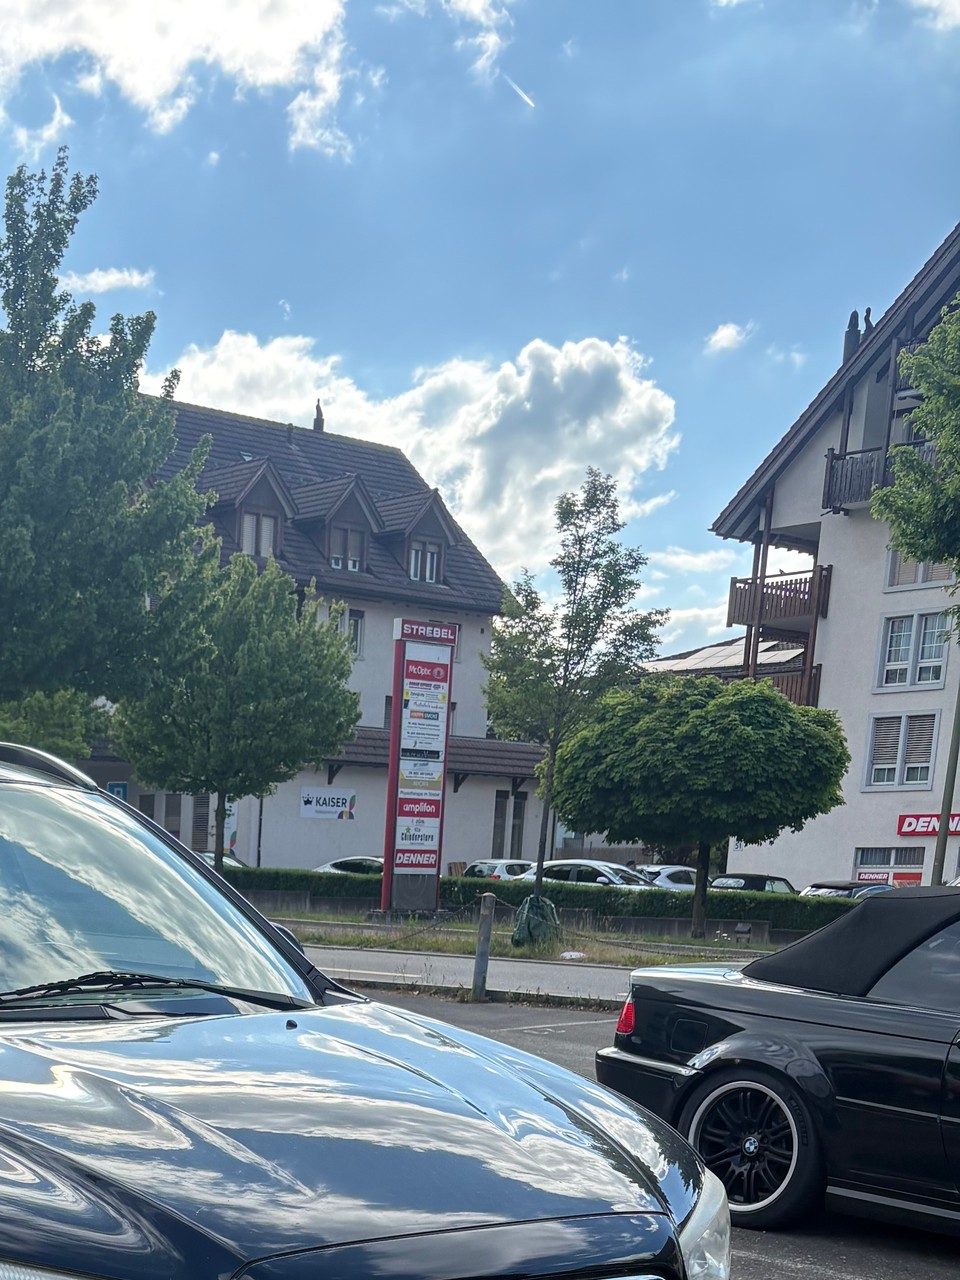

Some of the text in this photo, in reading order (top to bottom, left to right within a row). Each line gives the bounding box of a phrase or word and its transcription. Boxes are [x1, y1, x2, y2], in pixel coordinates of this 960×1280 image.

[403, 624, 455, 639] STREBEL
[408, 665, 432, 676] McOptic
[315, 796, 347, 808] KAISER
[403, 802, 436, 814] amplifon
[901, 816, 960, 832] DENN
[396, 852, 437, 865] DENNER
